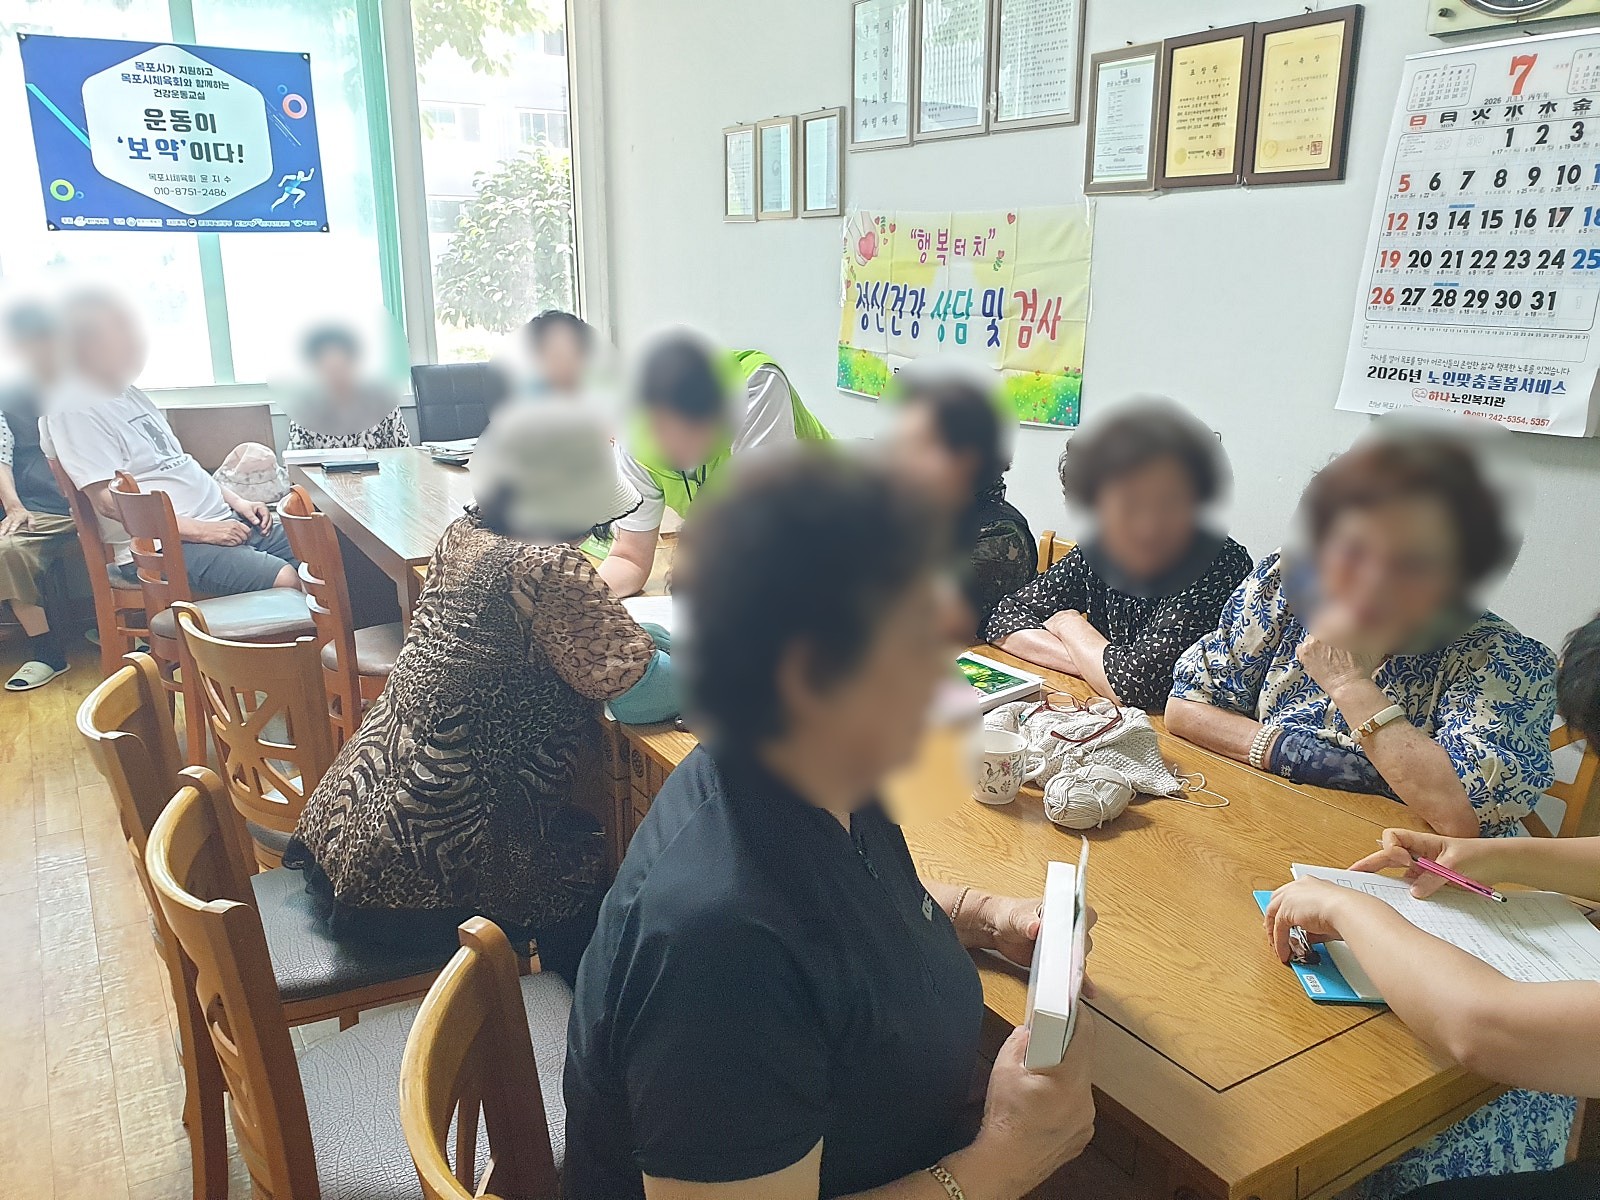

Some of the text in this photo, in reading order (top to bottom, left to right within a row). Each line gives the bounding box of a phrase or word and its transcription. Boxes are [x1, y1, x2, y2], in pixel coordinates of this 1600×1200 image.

[135, 61, 214, 77] 목포시가 지원하고
[1508, 52, 1539, 96] 7
[121, 73, 230, 90] 목포시체육회와 함께하는
[153, 88, 206, 101] 건강운동교실
[1483, 96, 1502, 106] 2026
[143, 108, 217, 134] 운동이
[1409, 114, 1428, 127] 日
[1440, 111, 1458, 124] 月
[1471, 107, 1492, 122] 火
[1503, 104, 1525, 118] 水
[1571, 97, 1593, 112] 金
[1505, 127, 1515, 148] 1
[1535, 123, 1550, 145] 2
[1569, 120, 1585, 142] 3
[148, 173, 197, 183] 목포시체육회
[1398, 174, 1411, 193] 5
[1429, 172, 1441, 191] 6
[1459, 170, 1476, 190] 7
[1493, 168, 1508, 188] 8
[1528, 166, 1542, 187] 9
[1556, 164, 1582, 186] 10
[153, 187, 227, 197] 010-8751-2486
[1387, 212, 1409, 231] 12
[1417, 211, 1439, 230] 13
[1448, 210, 1471, 230] 14
[1480, 209, 1504, 230] 15
[1514, 208, 1537, 229] 16
[1548, 206, 1575, 228] 17
[1380, 248, 1600, 270] 19 20 21 22 23 24 25
[1370, 286, 1395, 305] 26
[1399, 287, 1427, 306] 27
[1430, 288, 1458, 307] 28
[1462, 289, 1490, 308] 29
[1494, 289, 1522, 310] 30
[1529, 290, 1557, 311] 31
[855, 281, 1063, 349] 정신건강 상담 및 검사
[1366, 365, 1567, 395] 2026년 노인맞춤돌봄서비스
[1428, 390, 1506, 408] 하나노인복지관
[1530, 417, 1550, 427] 5357
